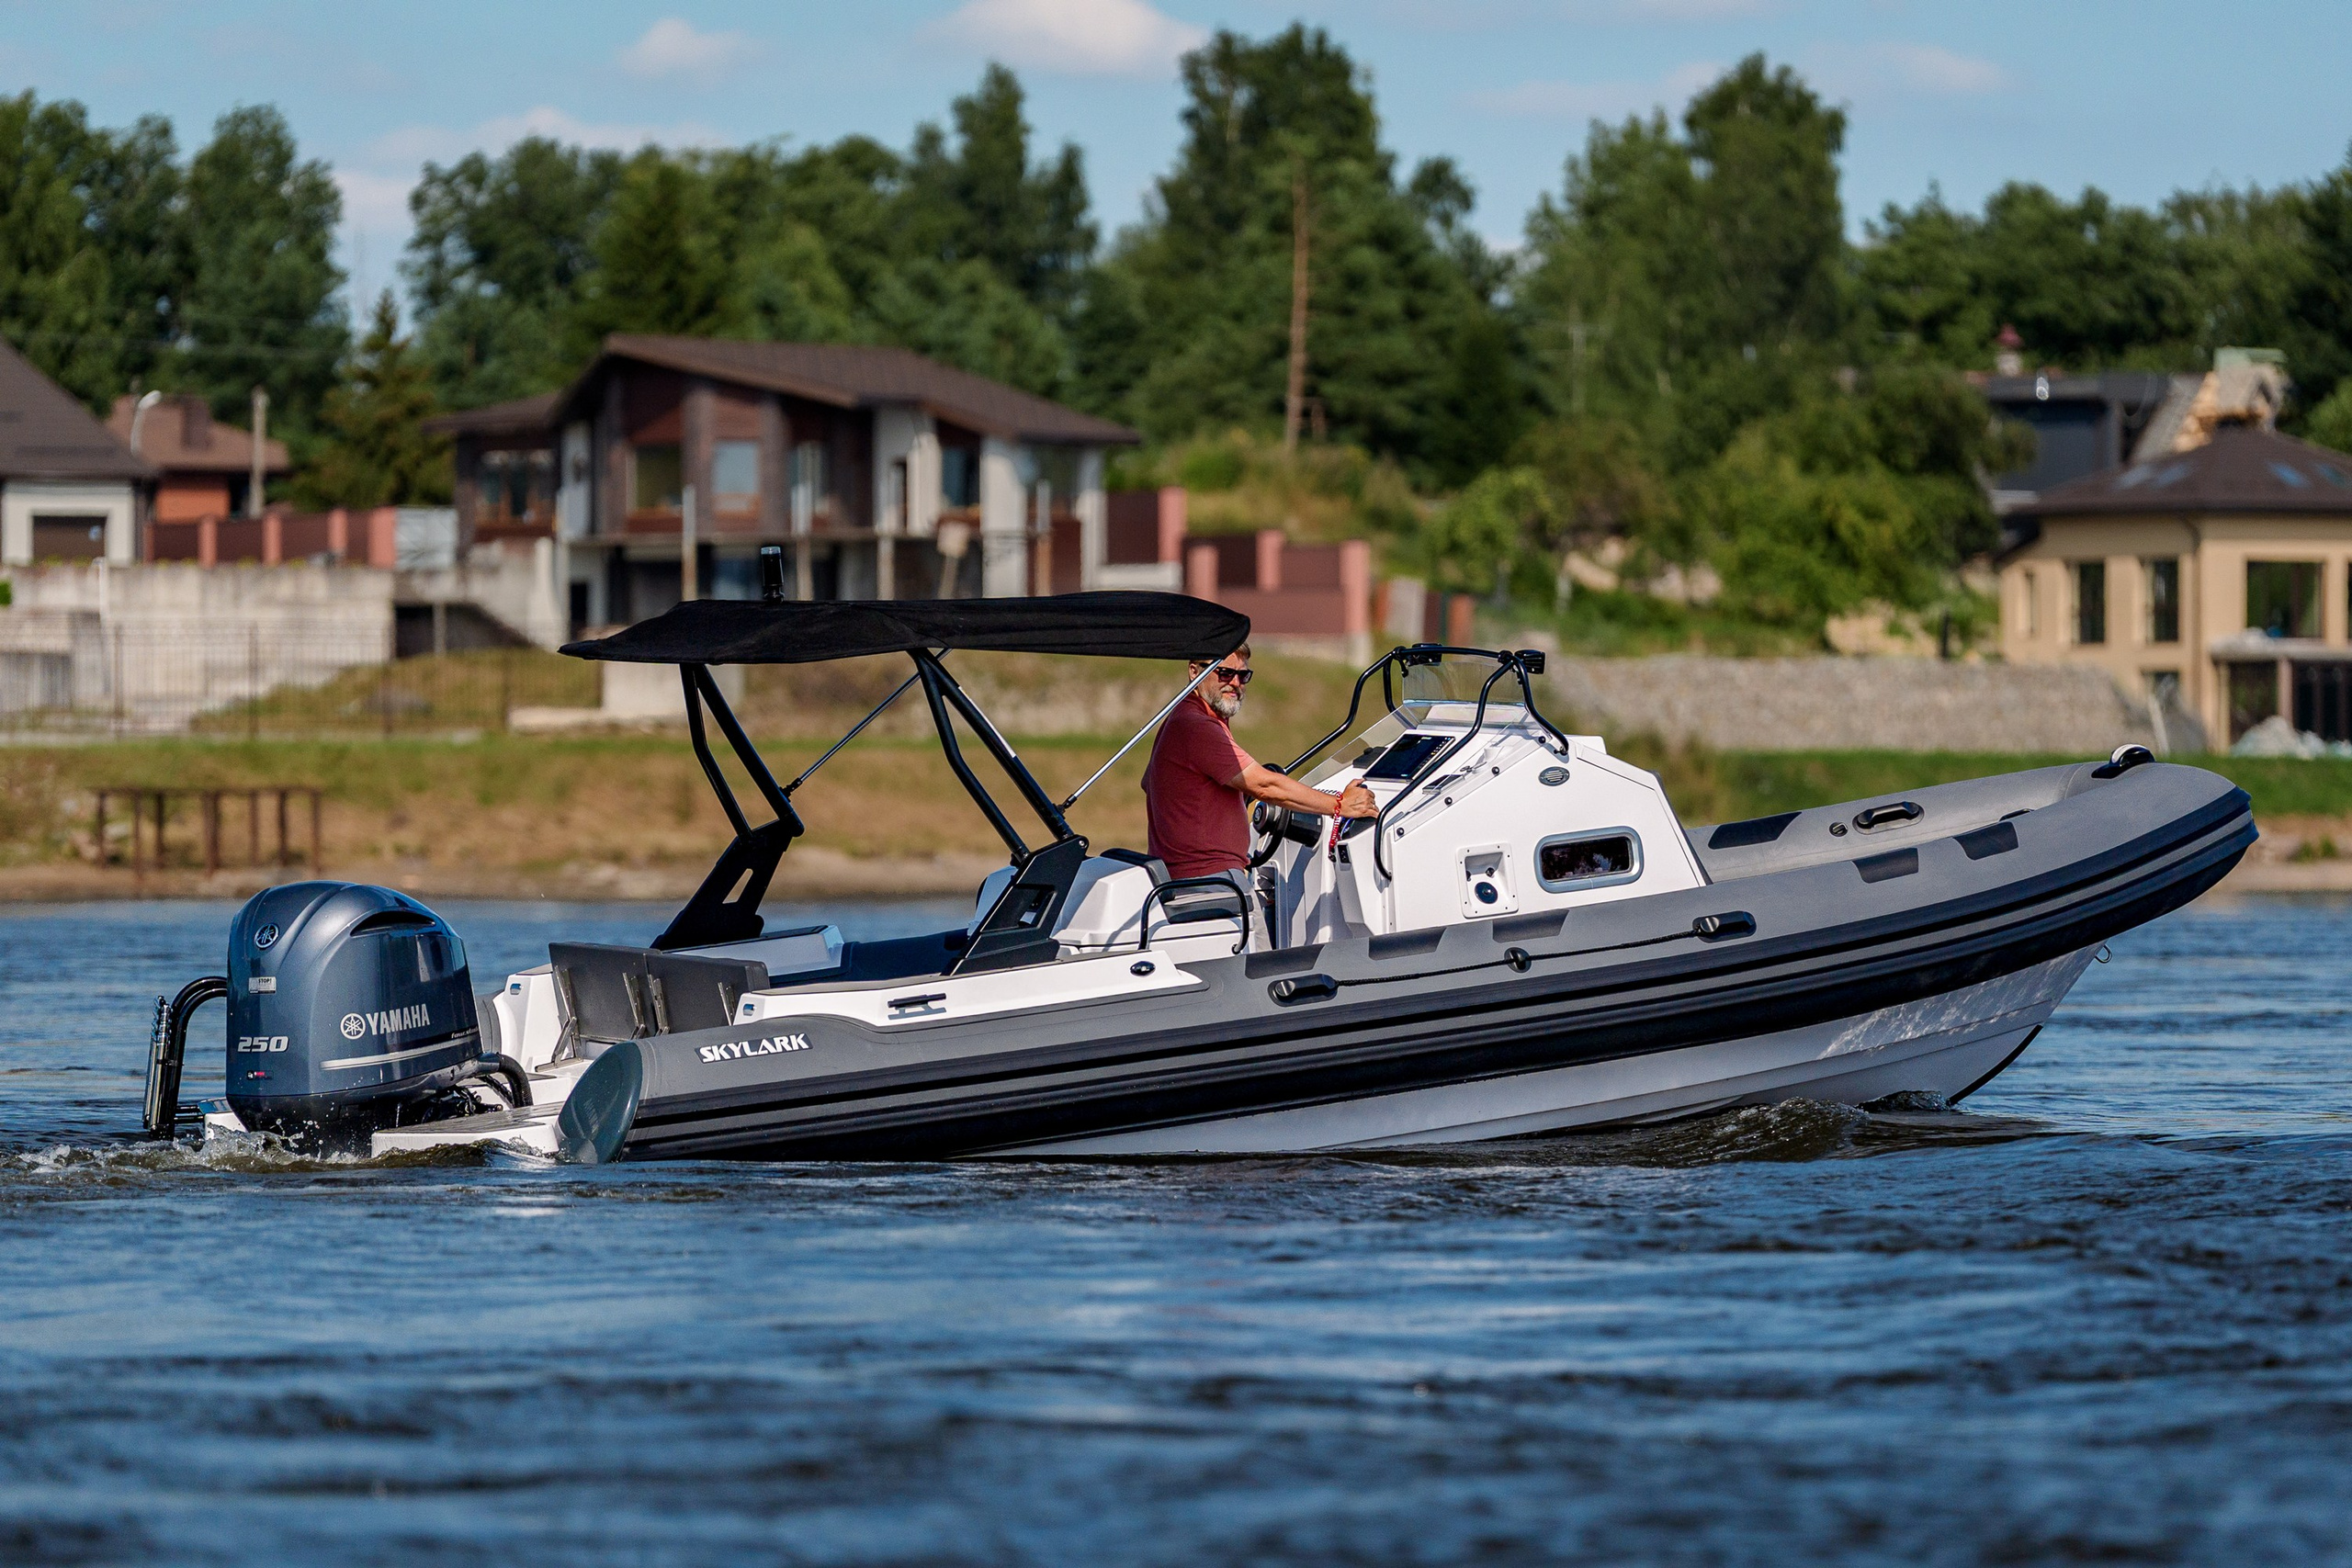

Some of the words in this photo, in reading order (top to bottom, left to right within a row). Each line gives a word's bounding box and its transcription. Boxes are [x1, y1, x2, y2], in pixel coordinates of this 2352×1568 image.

[366, 1003, 430, 1035] YAMAHA
[238, 1036, 289, 1053] 250
[699, 1033, 808, 1063] SKYLARK
